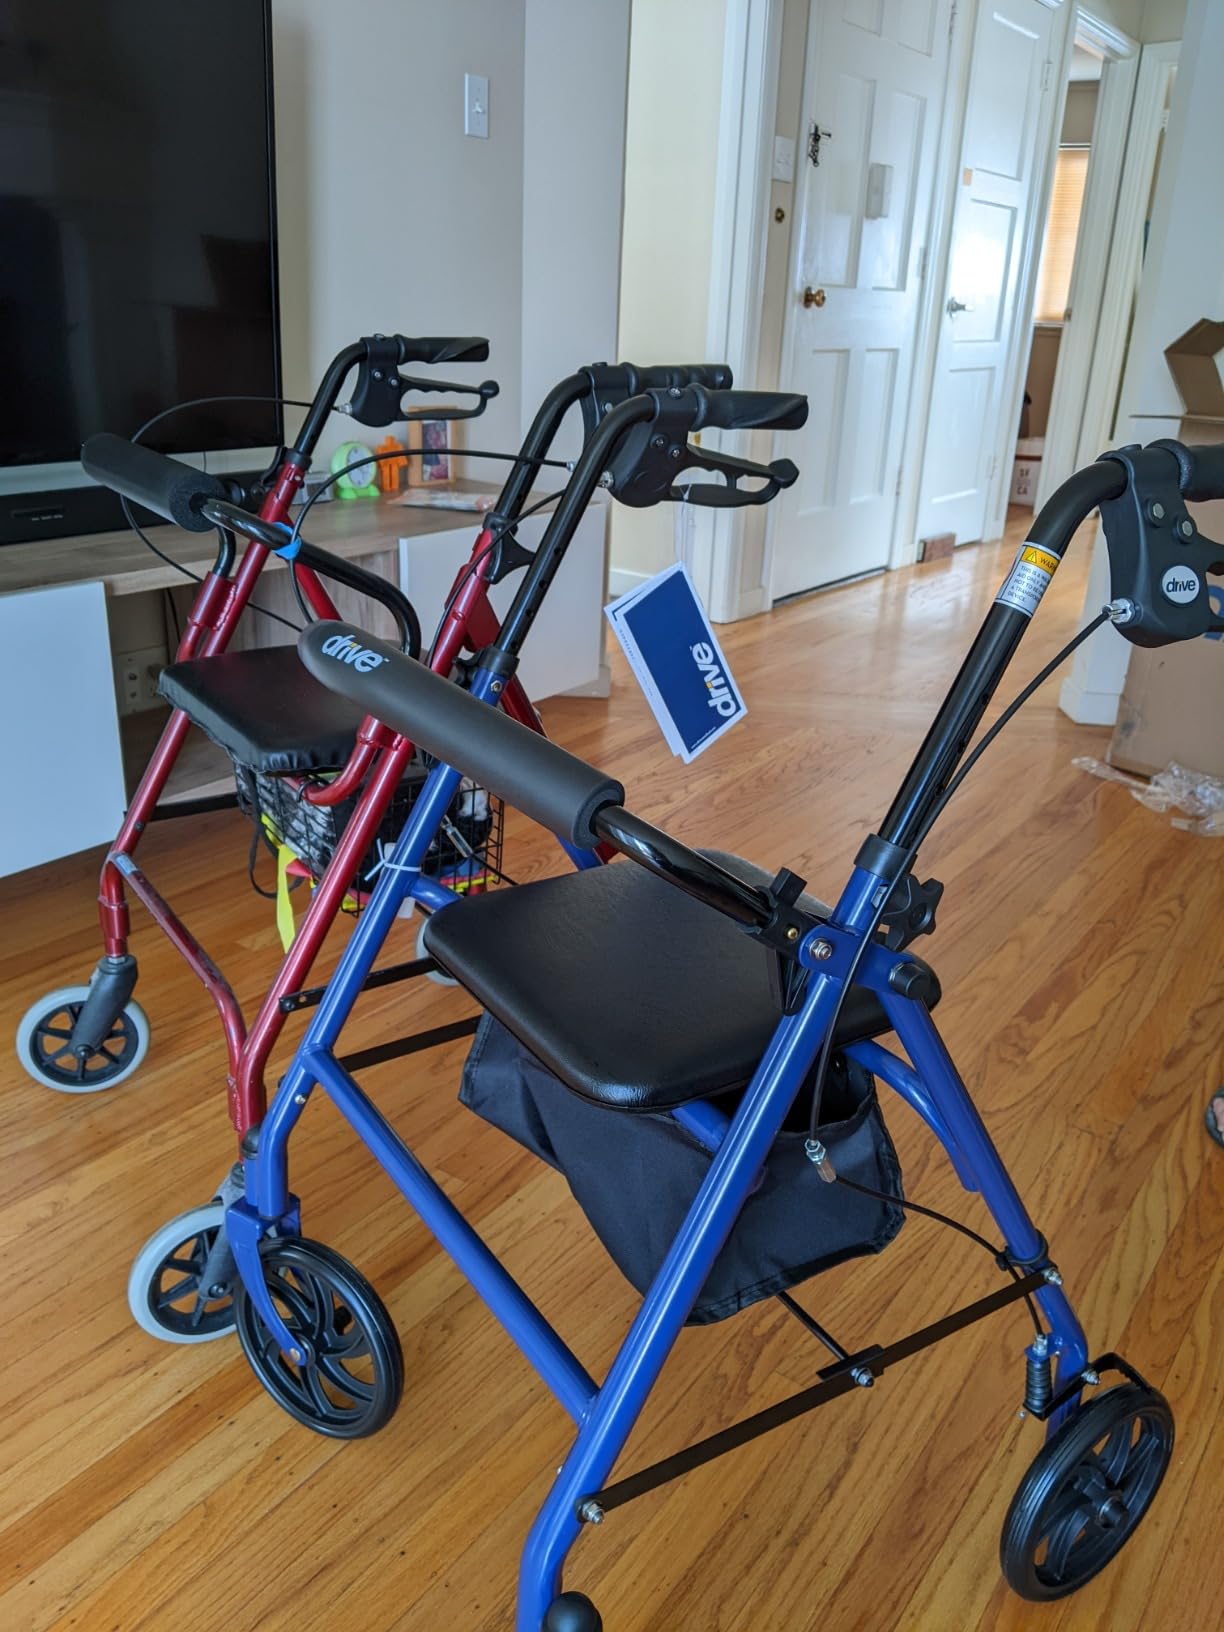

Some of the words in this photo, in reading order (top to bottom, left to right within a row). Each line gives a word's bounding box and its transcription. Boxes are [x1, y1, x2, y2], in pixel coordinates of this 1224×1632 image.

[1166, 578, 1196, 593] drive
[322, 634, 384, 673] drive
[692, 642, 737, 717] drive
